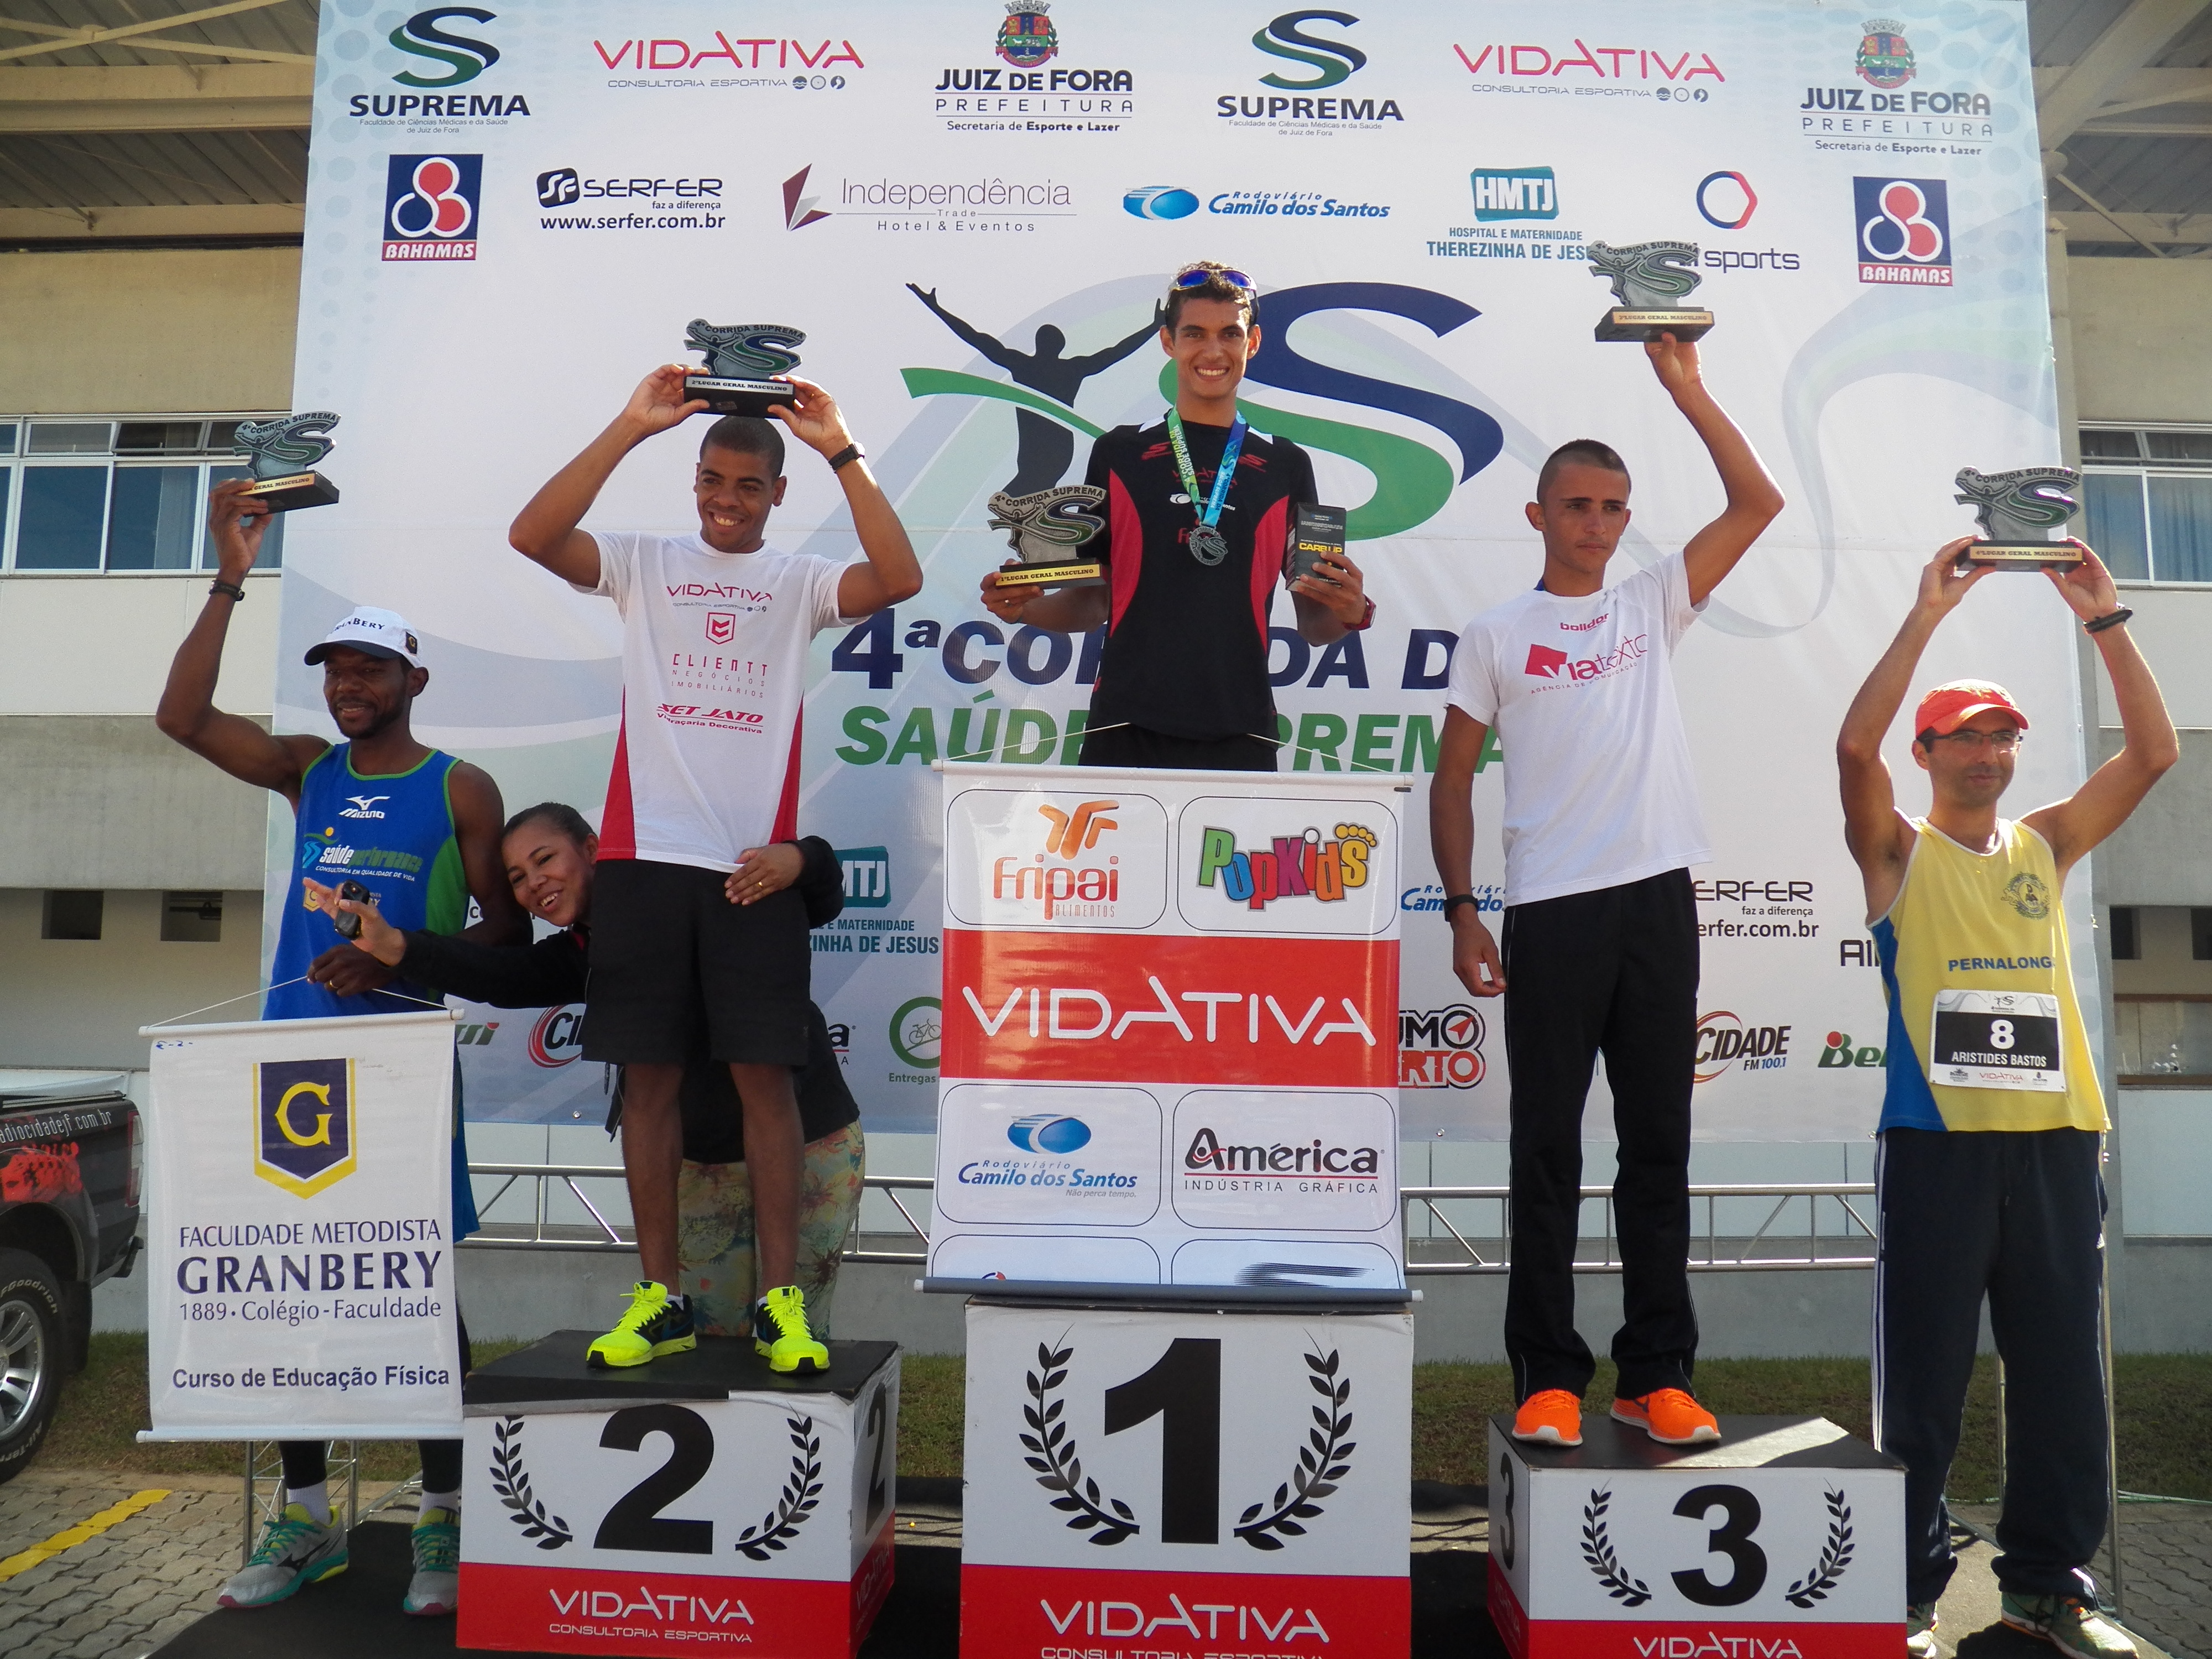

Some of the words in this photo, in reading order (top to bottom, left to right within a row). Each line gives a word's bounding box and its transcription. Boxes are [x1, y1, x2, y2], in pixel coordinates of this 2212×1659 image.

[594, 30, 864, 70] VIDATIVA
[1453, 39, 1725, 82] VIDATIVA
[608, 79, 705, 87] CONSULTORIA
[711, 79, 787, 87] ESPORTIVA
[935, 69, 1001, 91] JUIZ
[1009, 72, 1043, 91] DE
[1051, 69, 1133, 91] FORA
[1472, 84, 1569, 95] CONSULTORIA
[1575, 87, 1651, 97] ESPORTIVA
[349, 95, 531, 117] SUPREMA
[936, 98, 1133, 112] PREFEITURA
[1217, 95, 1405, 121] SUPREMA
[1800, 88, 1865, 111] JUIZ
[1871, 93, 1905, 112] DE
[1911, 91, 1990, 116] FORA
[947, 121, 1005, 131] Secretaria
[1009, 121, 1022, 131] de
[1026, 121, 1073, 133] Esporte
[1088, 121, 1120, 132] Lazer
[1802, 117, 1992, 137] PREFEITURA
[1815, 140, 1871, 152] Secretaria
[1875, 142, 1888, 152] de
[1892, 143, 1937, 155] Esporte
[1950, 145, 1982, 155] Lazer
[583, 178, 723, 197] SERFER
[843, 178, 1071, 210] Independência
[1233, 191, 1322, 200] Rodoviário
[1475, 176, 1553, 211] HMTJ
[652, 201, 666, 209] faz
[676, 200, 721, 211] diferença
[937, 209, 977, 217] Trade
[1208, 194, 1278, 215] Camilo
[1282, 200, 1318, 216] dos
[1321, 199, 1390, 217] Santos
[541, 213, 725, 229] www.serfer.com.br
[877, 221, 930, 231] Hotel
[938, 221, 947, 231] &
[956, 221, 1035, 232] Eventos
[1449, 227, 1498, 238] HOSPITAL
[1501, 229, 1506, 238] E
[1511, 229, 1583, 241] MATERNIDADE
[385, 243, 474, 259] BAHAMAS
[1427, 241, 1526, 258] THEREZINHA
[1532, 244, 1552, 259] DE
[1606, 244, 1649, 255] CORRIDA
[1650, 242, 1698, 254] SUPREMA
[1704, 247, 1800, 273] sports
[1863, 265, 1950, 284] BAHAMAS
[705, 325, 750, 333] CORRIDA
[753, 325, 803, 338] SUPREMA
[251, 419, 290, 434] CORRIDA
[293, 413, 336, 422] SUPREMA
[275, 477, 310, 487] MASCULINO
[1975, 472, 2023, 483] CORRIDA
[2026, 468, 2079, 482] SUPREMA
[1005, 492, 1051, 507] CORRIDA
[1052, 486, 1103, 498] SUPREMA
[1055, 568, 1094, 577] MASCULINO
[666, 582, 773, 602] VIDATIVA
[672, 654, 768, 676] CLIENTT
[672, 670, 764, 687] NEGÓCIOS
[671, 681, 763, 698] IMOBILIÁRIOS
[701, 708, 764, 723] JATO
[709, 722, 762, 734] Decorativa
[338, 808, 385, 818] MIZUNO
[315, 865, 351, 874] CONSULTORIA
[993, 854, 1119, 920] Fripai
[1693, 880, 1813, 902] ERFER
[1056, 903, 1116, 919] ALIMENTOS
[1742, 906, 1756, 916] faz
[1767, 906, 1813, 917] diferença
[837, 919, 915, 931] MATERNIDADE
[859, 936, 880, 953] DE
[886, 936, 939, 954] JESUS
[1948, 956, 2053, 972] PERNALONG
[962, 975, 1376, 1046] VIDATIVA
[1990, 1019, 2015, 1050] 8
[1695, 1026, 1792, 1065] CIDADE
[1744, 1059, 1759, 1071] FM
[1761, 1057, 1786, 1070] 100,1
[1952, 1051, 2008, 1065] ARISTIDES
[2010, 1054, 2047, 1067] BASTOS
[889, 1072, 936, 1084] Entregas
[1979, 1072, 2023, 1081] VIDATIVA
[274, 1081, 333, 1147] G
[1185, 1128, 1378, 1174] América
[983, 1160, 1071, 1169] Rodoviário
[958, 1162, 1026, 1185] Camilo
[1030, 1169, 1066, 1187] dos
[1069, 1168, 1138, 1188] Santos
[1185, 1177, 1283, 1192] INDÚSTRIA
[1299, 1180, 1378, 1194] GRÁFICA
[180, 1223, 304, 1248] FACULDADE
[312, 1219, 441, 1244] METODISTA
[176, 1250, 442, 1294] GRANBERY
[180, 1302, 227, 1321] 1889
[242, 1300, 319, 1326] Colégio
[333, 1296, 441, 1319] Faculdade
[173, 1368, 235, 1389] Curso
[241, 1368, 265, 1388] de
[273, 1367, 378, 1391] Educação
[385, 1365, 449, 1386] Física
[1104, 1337, 1221, 1545] 1
[593, 1404, 714, 1555] 2
[1500, 1452, 1515, 1570] 3
[1671, 1484, 1767, 1607] 3
[549, 1586, 754, 1625] VIDATIVA
[1040, 1593, 1329, 1643] VIDATIVA
[549, 1623, 659, 1640] CONSULTORIA
[664, 1630, 753, 1643] ESPORTIVA
[1633, 1631, 1803, 1658] VIDATIVA
